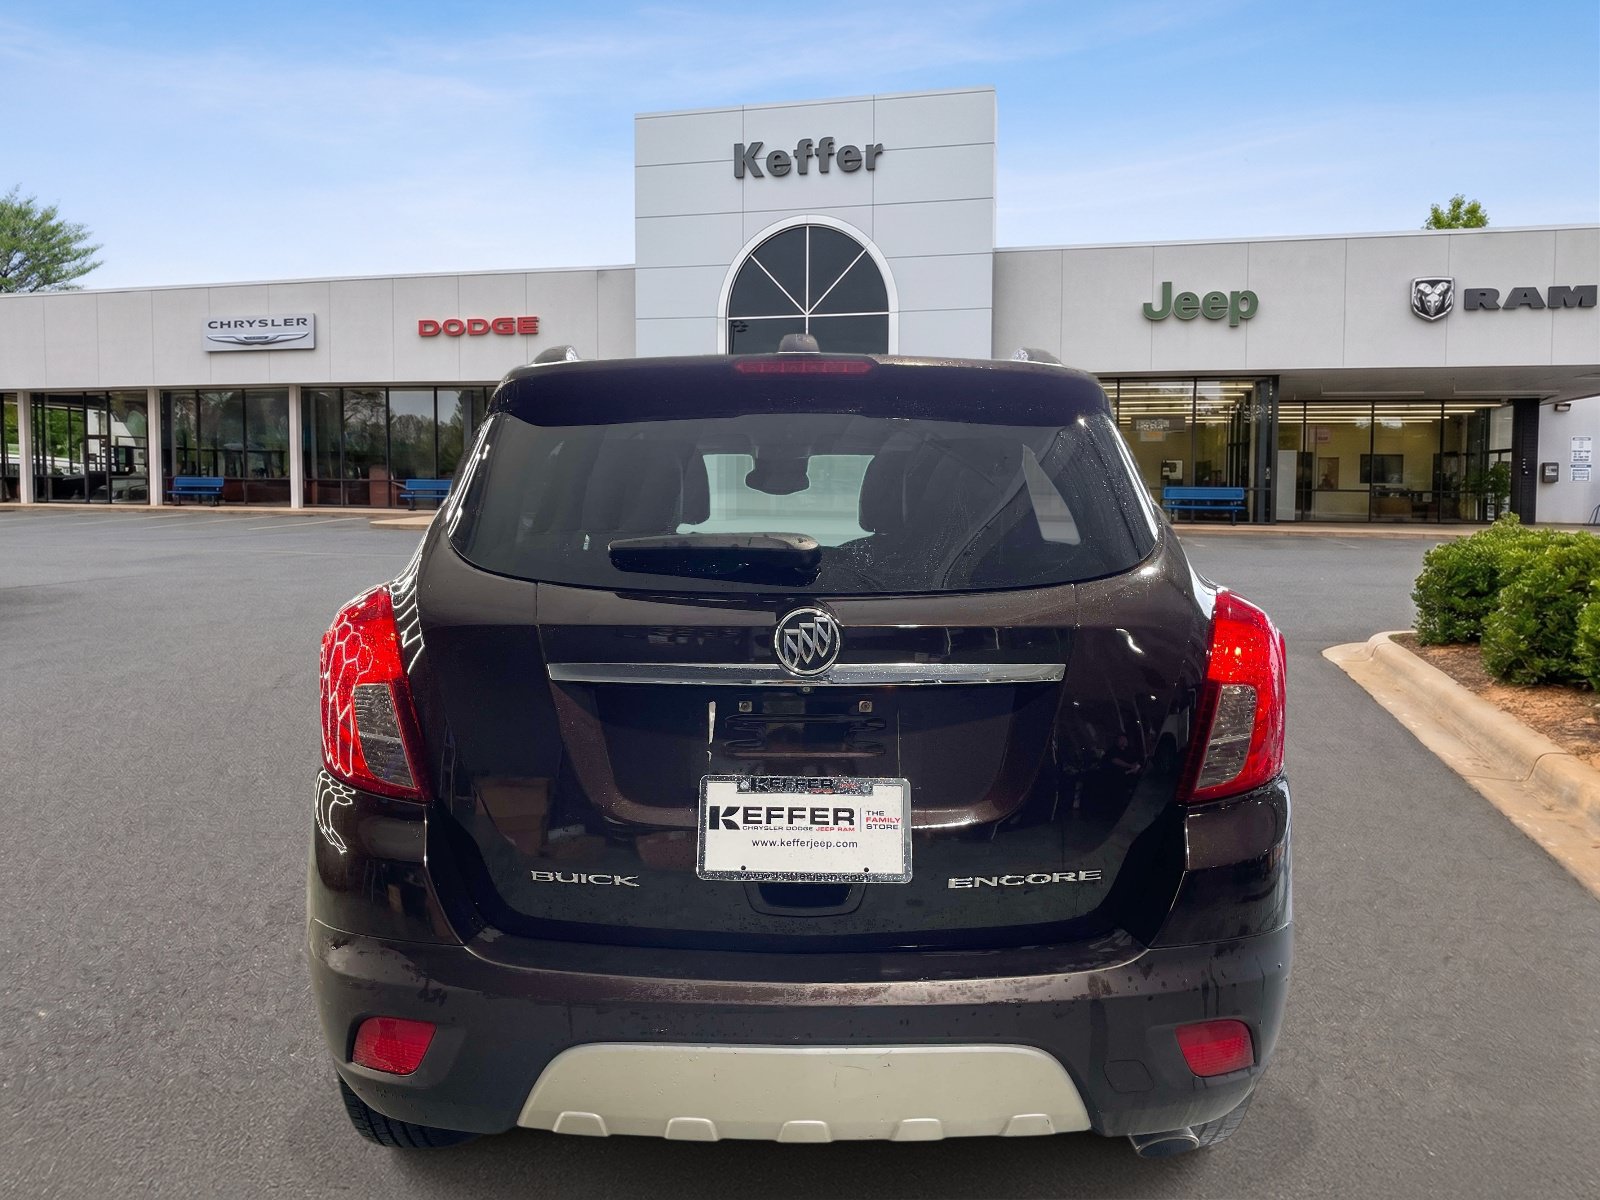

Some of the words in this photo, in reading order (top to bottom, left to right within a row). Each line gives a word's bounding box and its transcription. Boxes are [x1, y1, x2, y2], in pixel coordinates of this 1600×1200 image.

[733, 136, 884, 179] Keffer
[1143, 281, 1259, 328] Jeep
[1464, 284, 1598, 311] RAM
[207, 317, 308, 330] CHRYSLER
[418, 316, 539, 337] DODGE
[708, 805, 855, 831] KEFFER
[865, 816, 901, 824] FAMILY
[751, 838, 858, 849] www.kefferjeep.com
[530, 870, 640, 887] BUICK
[947, 869, 1102, 889] ENCORE
